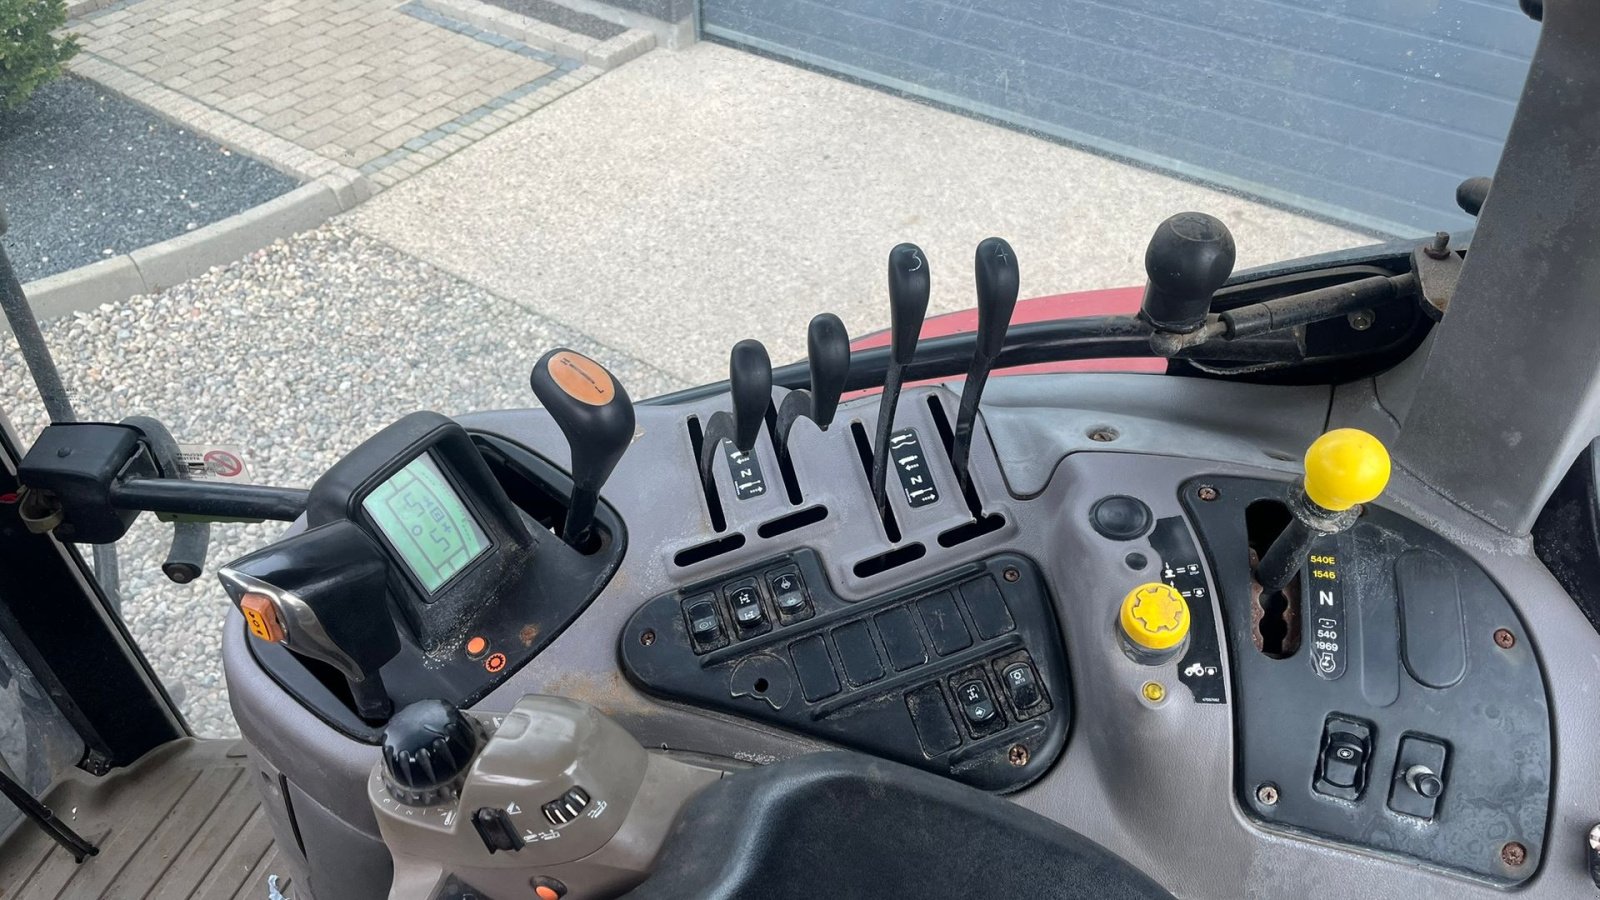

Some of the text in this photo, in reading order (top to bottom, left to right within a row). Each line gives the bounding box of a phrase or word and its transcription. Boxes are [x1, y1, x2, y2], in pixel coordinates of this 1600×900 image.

[902, 248, 922, 272] 3
[740, 468, 752, 478] N
[910, 475, 923, 485] N
[1310, 555, 1335, 565] 540E
[1313, 570, 1336, 579] 1546
[1319, 590, 1334, 606] N
[1317, 629, 1337, 640] 540
[1315, 641, 1338, 652] 1969
